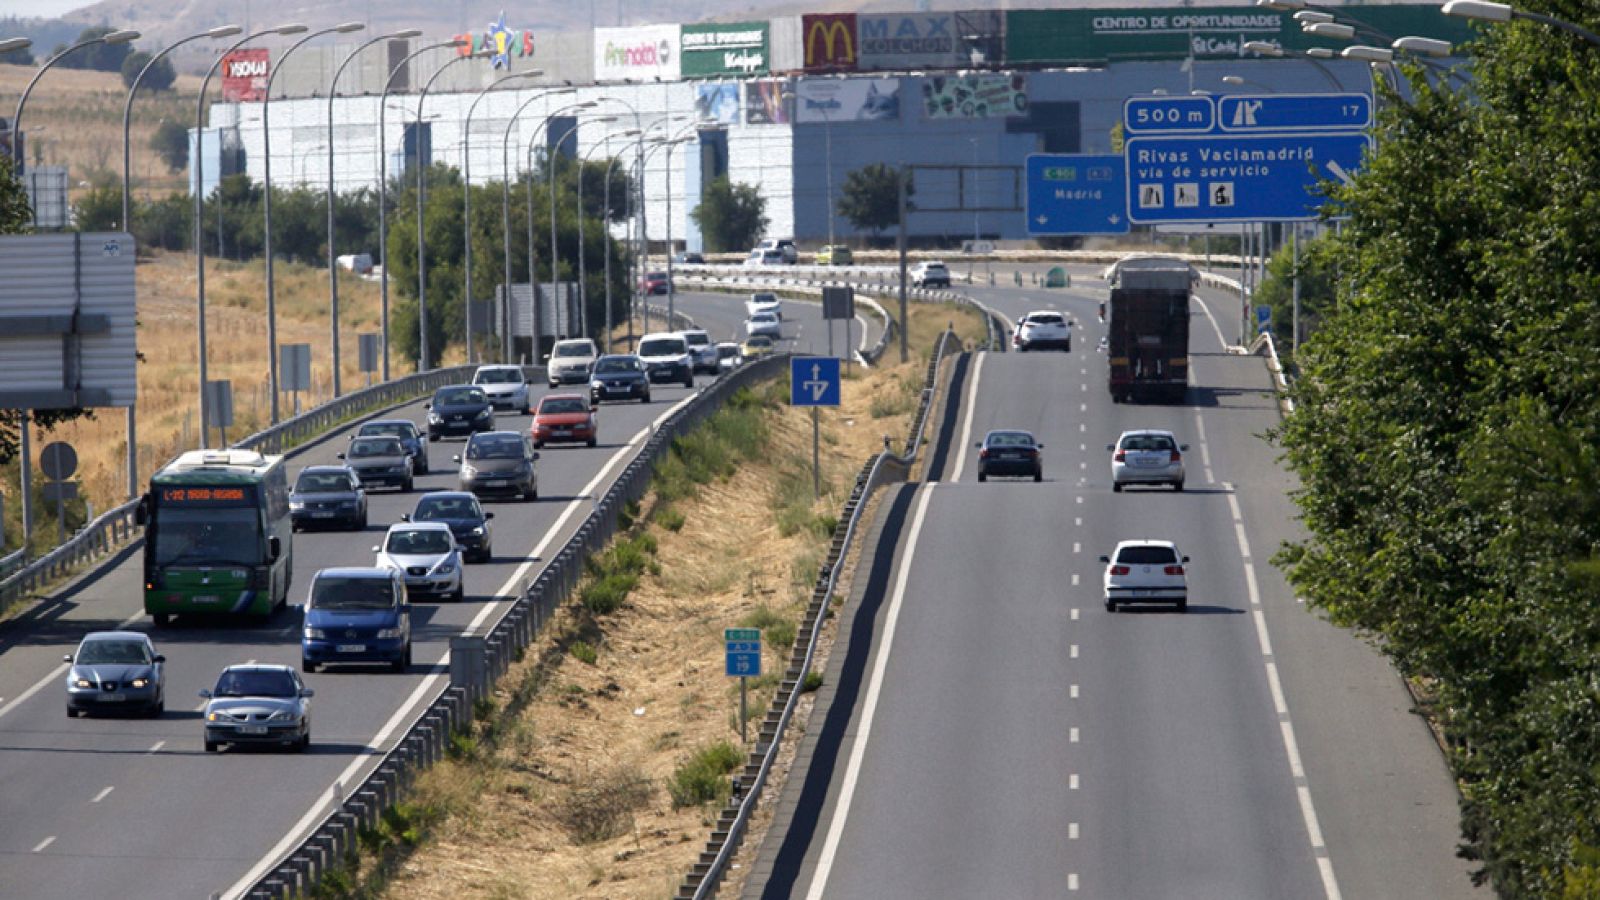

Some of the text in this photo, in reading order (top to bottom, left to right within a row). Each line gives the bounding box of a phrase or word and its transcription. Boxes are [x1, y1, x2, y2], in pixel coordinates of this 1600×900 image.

[862, 17, 950, 37] MAX
[1093, 14, 1282, 29] CENTRO DE OPORTUNIDADES
[1137, 108, 1203, 123] 500 m
[1342, 105, 1360, 117] 17
[1138, 146, 1314, 163] Rivas Vaciamadrid
[1172, 164, 1191, 177] de
[1200, 164, 1269, 176] servicio
[1055, 189, 1102, 200] Madrid
[737, 662, 750, 672] 19
